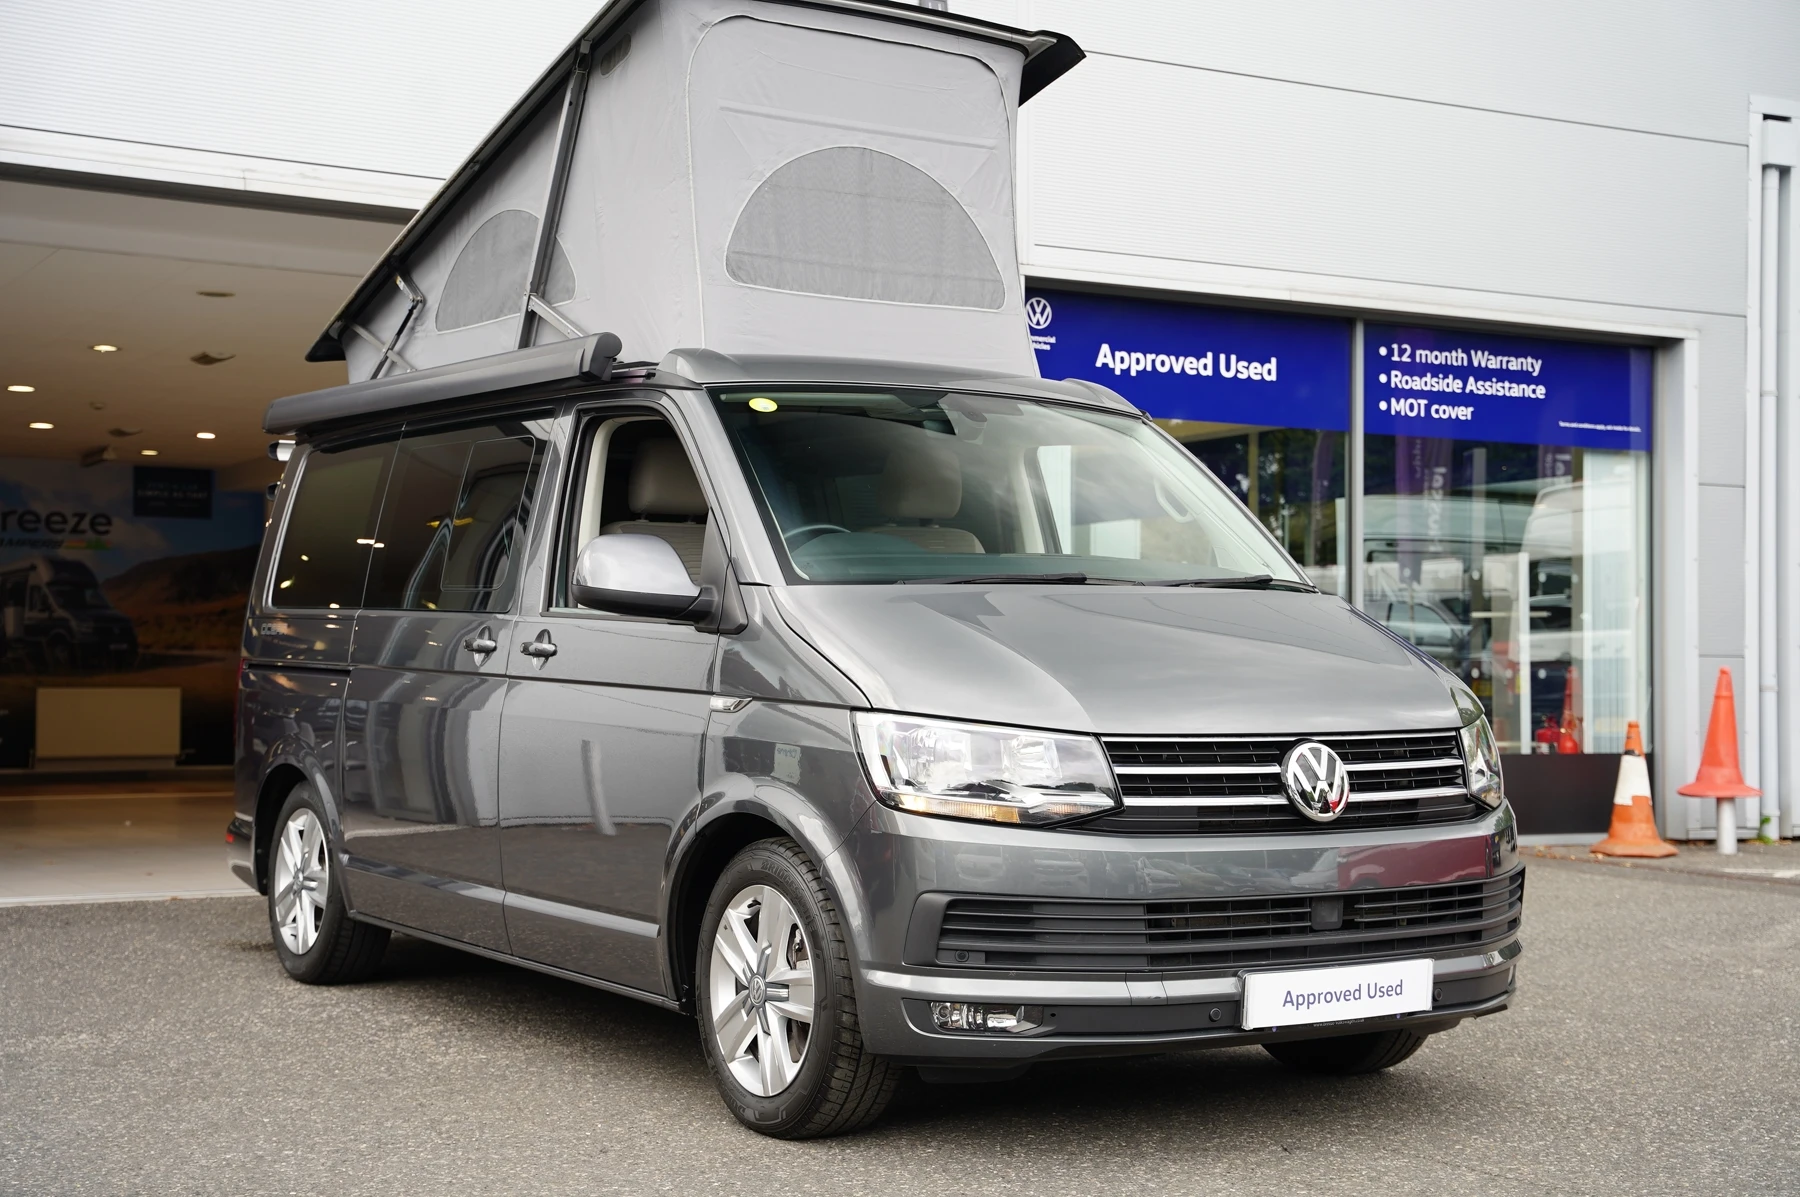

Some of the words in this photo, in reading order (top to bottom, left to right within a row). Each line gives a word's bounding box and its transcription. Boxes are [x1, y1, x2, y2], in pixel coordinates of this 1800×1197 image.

[1096, 343, 1213, 377] Approved
[1219, 353, 1277, 382] Used
[1391, 343, 1411, 363] 12
[1415, 348, 1468, 367] month
[1470, 349, 1543, 377] Warranty
[1391, 370, 1463, 394] Roadside
[1465, 375, 1547, 399] Assistance
[1391, 397, 1429, 418] MOT
[1430, 404, 1475, 421] cover
[1, 508, 113, 536] reeze
[1282, 983, 1362, 1011] Approved
[1367, 979, 1404, 1000] Used
